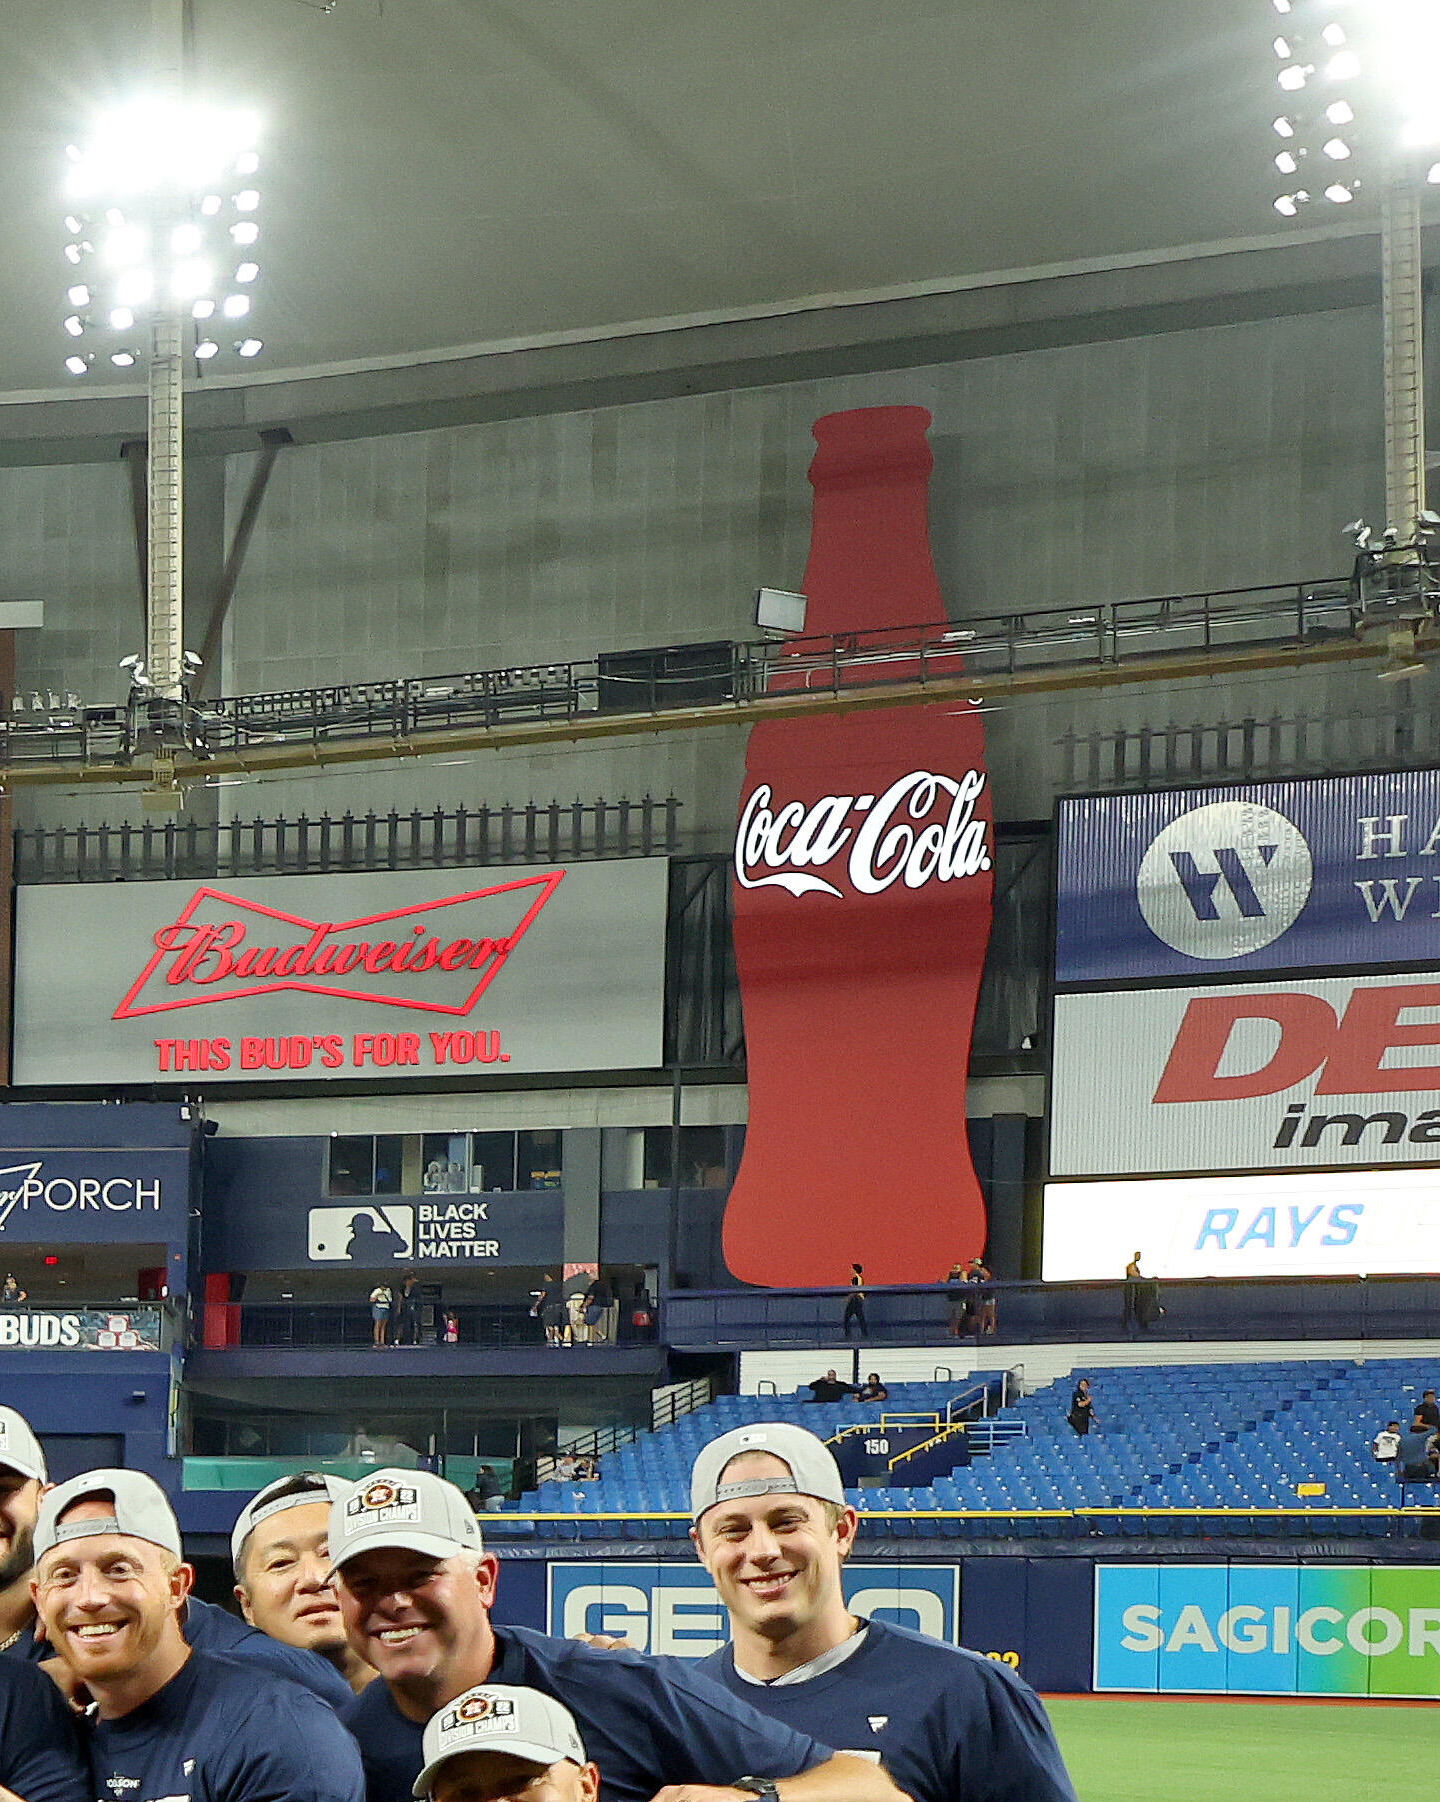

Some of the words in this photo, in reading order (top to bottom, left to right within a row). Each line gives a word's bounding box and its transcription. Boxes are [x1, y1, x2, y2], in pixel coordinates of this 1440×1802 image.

[734, 768, 993, 898] Coca-Cola
[152, 919, 515, 988] Budweiser
[156, 1038, 231, 1070] THIS
[240, 1036, 343, 1070] BUD'S
[352, 1034, 420, 1067] FOR
[429, 1030, 510, 1066] YOU.
[23, 1179, 159, 1210] PORCH
[419, 1204, 487, 1222] BLACK
[1194, 1204, 1364, 1250] RAYS
[419, 1223, 476, 1239] LIVES
[419, 1240, 499, 1258] MATTER
[0, 1314, 80, 1345] BUDS
[864, 1439, 889, 1454] 150
